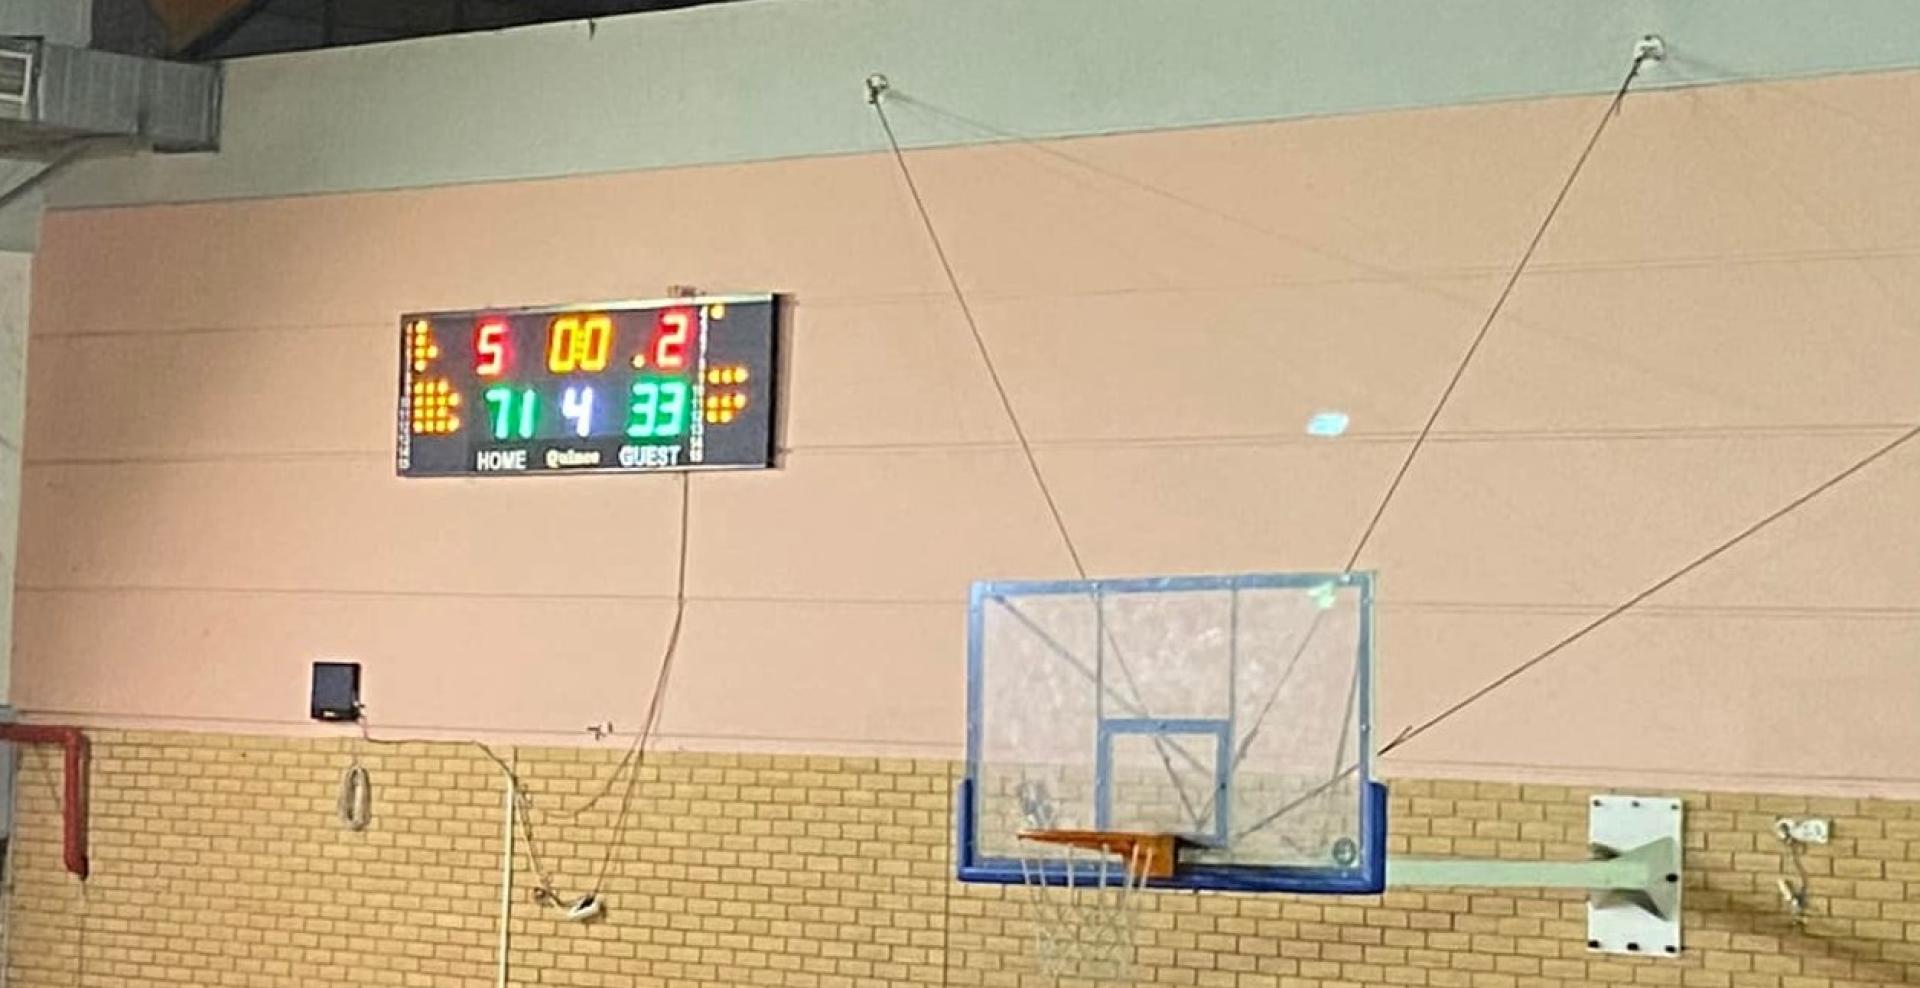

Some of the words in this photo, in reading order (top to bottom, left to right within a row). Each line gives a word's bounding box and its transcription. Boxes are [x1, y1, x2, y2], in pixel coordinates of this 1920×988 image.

[476, 323, 509, 375] 5
[485, 387, 535, 438] 71
[562, 387, 593, 437] 4
[626, 380, 686, 437] 33
[476, 450, 527, 471] HOME
[618, 444, 682, 467] GUEST
